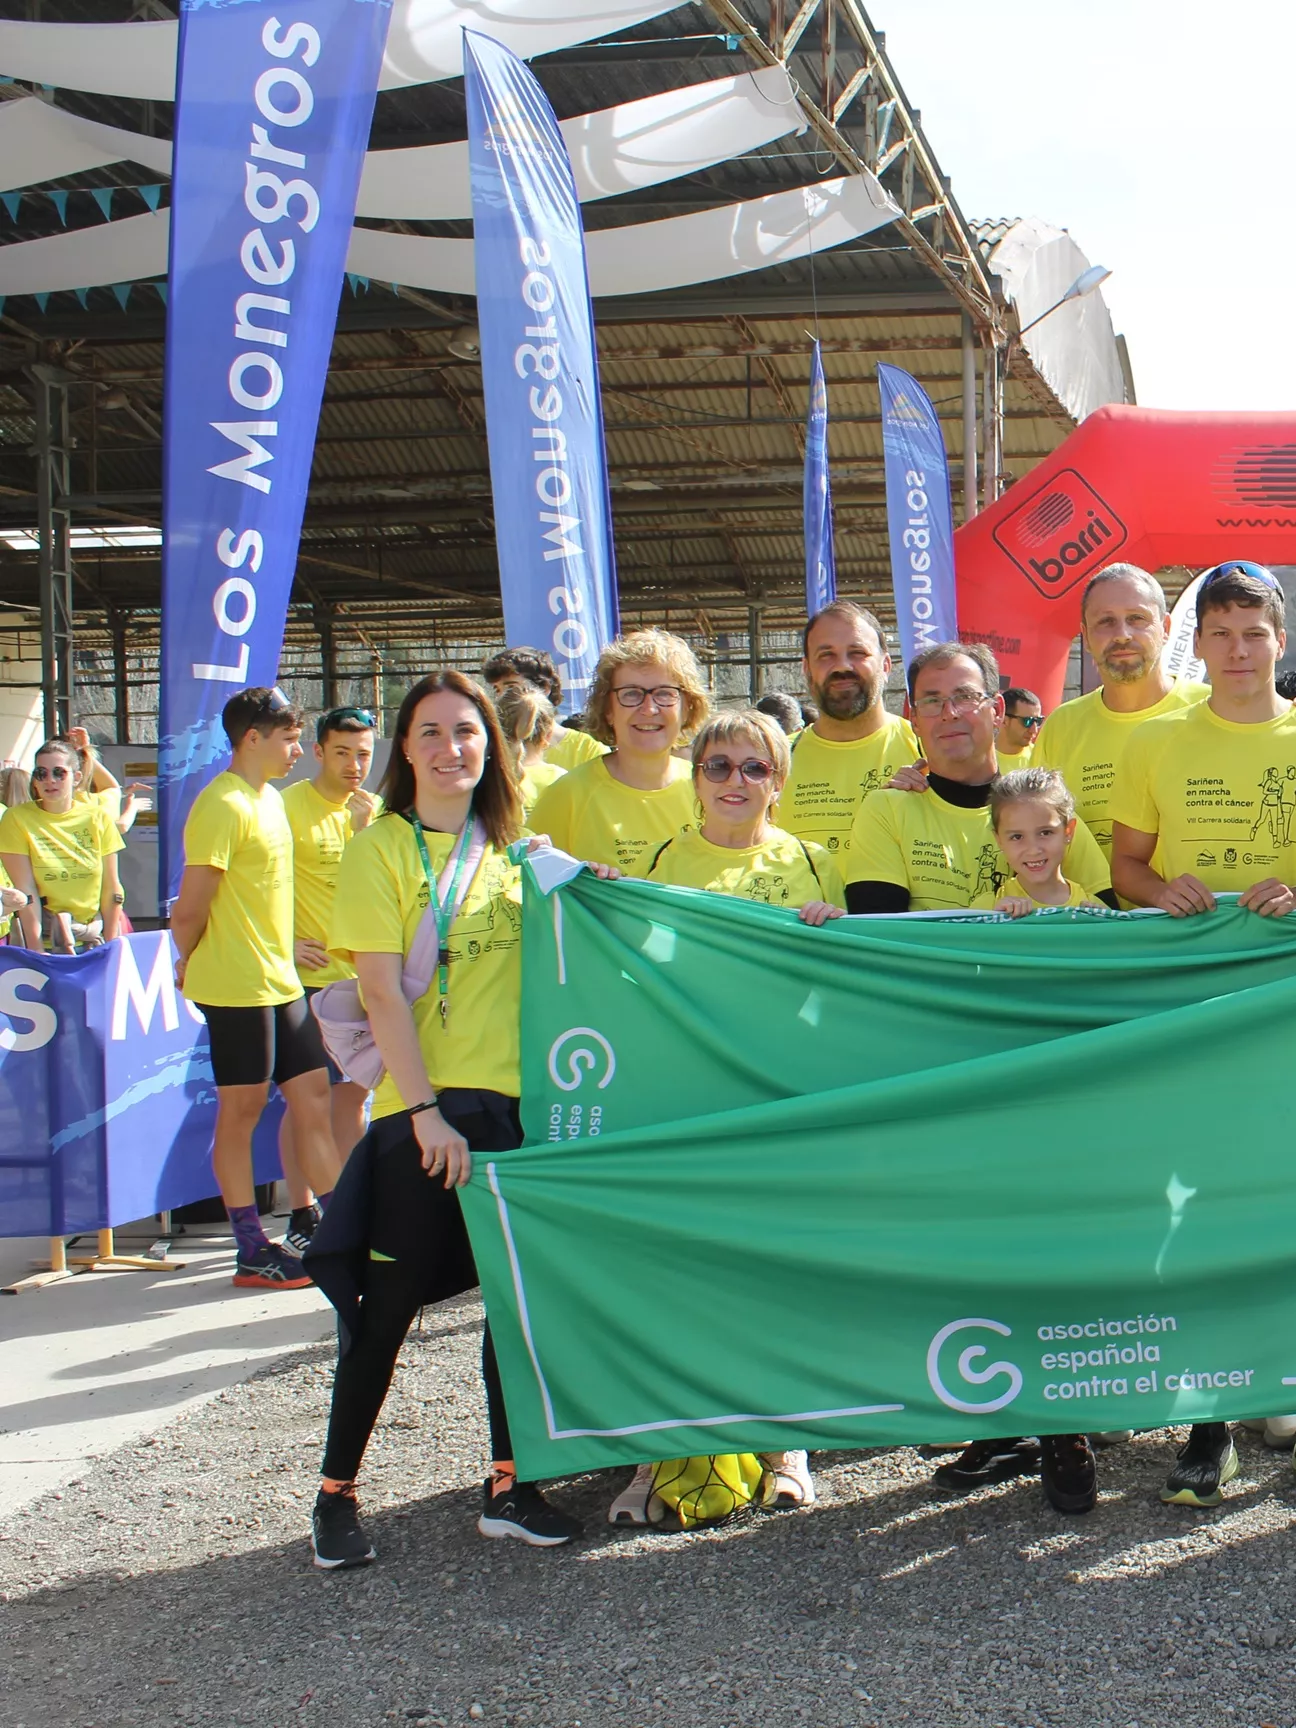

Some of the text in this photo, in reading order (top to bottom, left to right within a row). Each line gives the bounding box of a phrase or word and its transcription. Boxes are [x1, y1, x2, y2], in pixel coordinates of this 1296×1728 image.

[192, 16, 321, 685] Los Monegros
[1028, 510, 1113, 583] barri
[1167, 607, 1198, 676] MIENTO
[1082, 762, 1113, 773] Sariñena
[1092, 771, 1115, 781] march
[796, 781, 830, 790] Sariñena
[1186, 778, 1224, 786] Sariñena
[1082, 783, 1105, 792] contra
[1198, 788, 1231, 796] marcha
[794, 797, 819, 806] contra
[829, 796, 856, 804] cáncer
[1186, 799, 1213, 807] contra
[1225, 799, 1254, 807] cáncer
[913, 839, 944, 850] Sariñen
[911, 859, 938, 867] contra
[920, 875, 945, 885] Carrera
[1037, 1313, 1178, 1341] asociación
[1040, 1341, 1161, 1373] española
[1043, 1368, 1255, 1401] contra el cáncer
